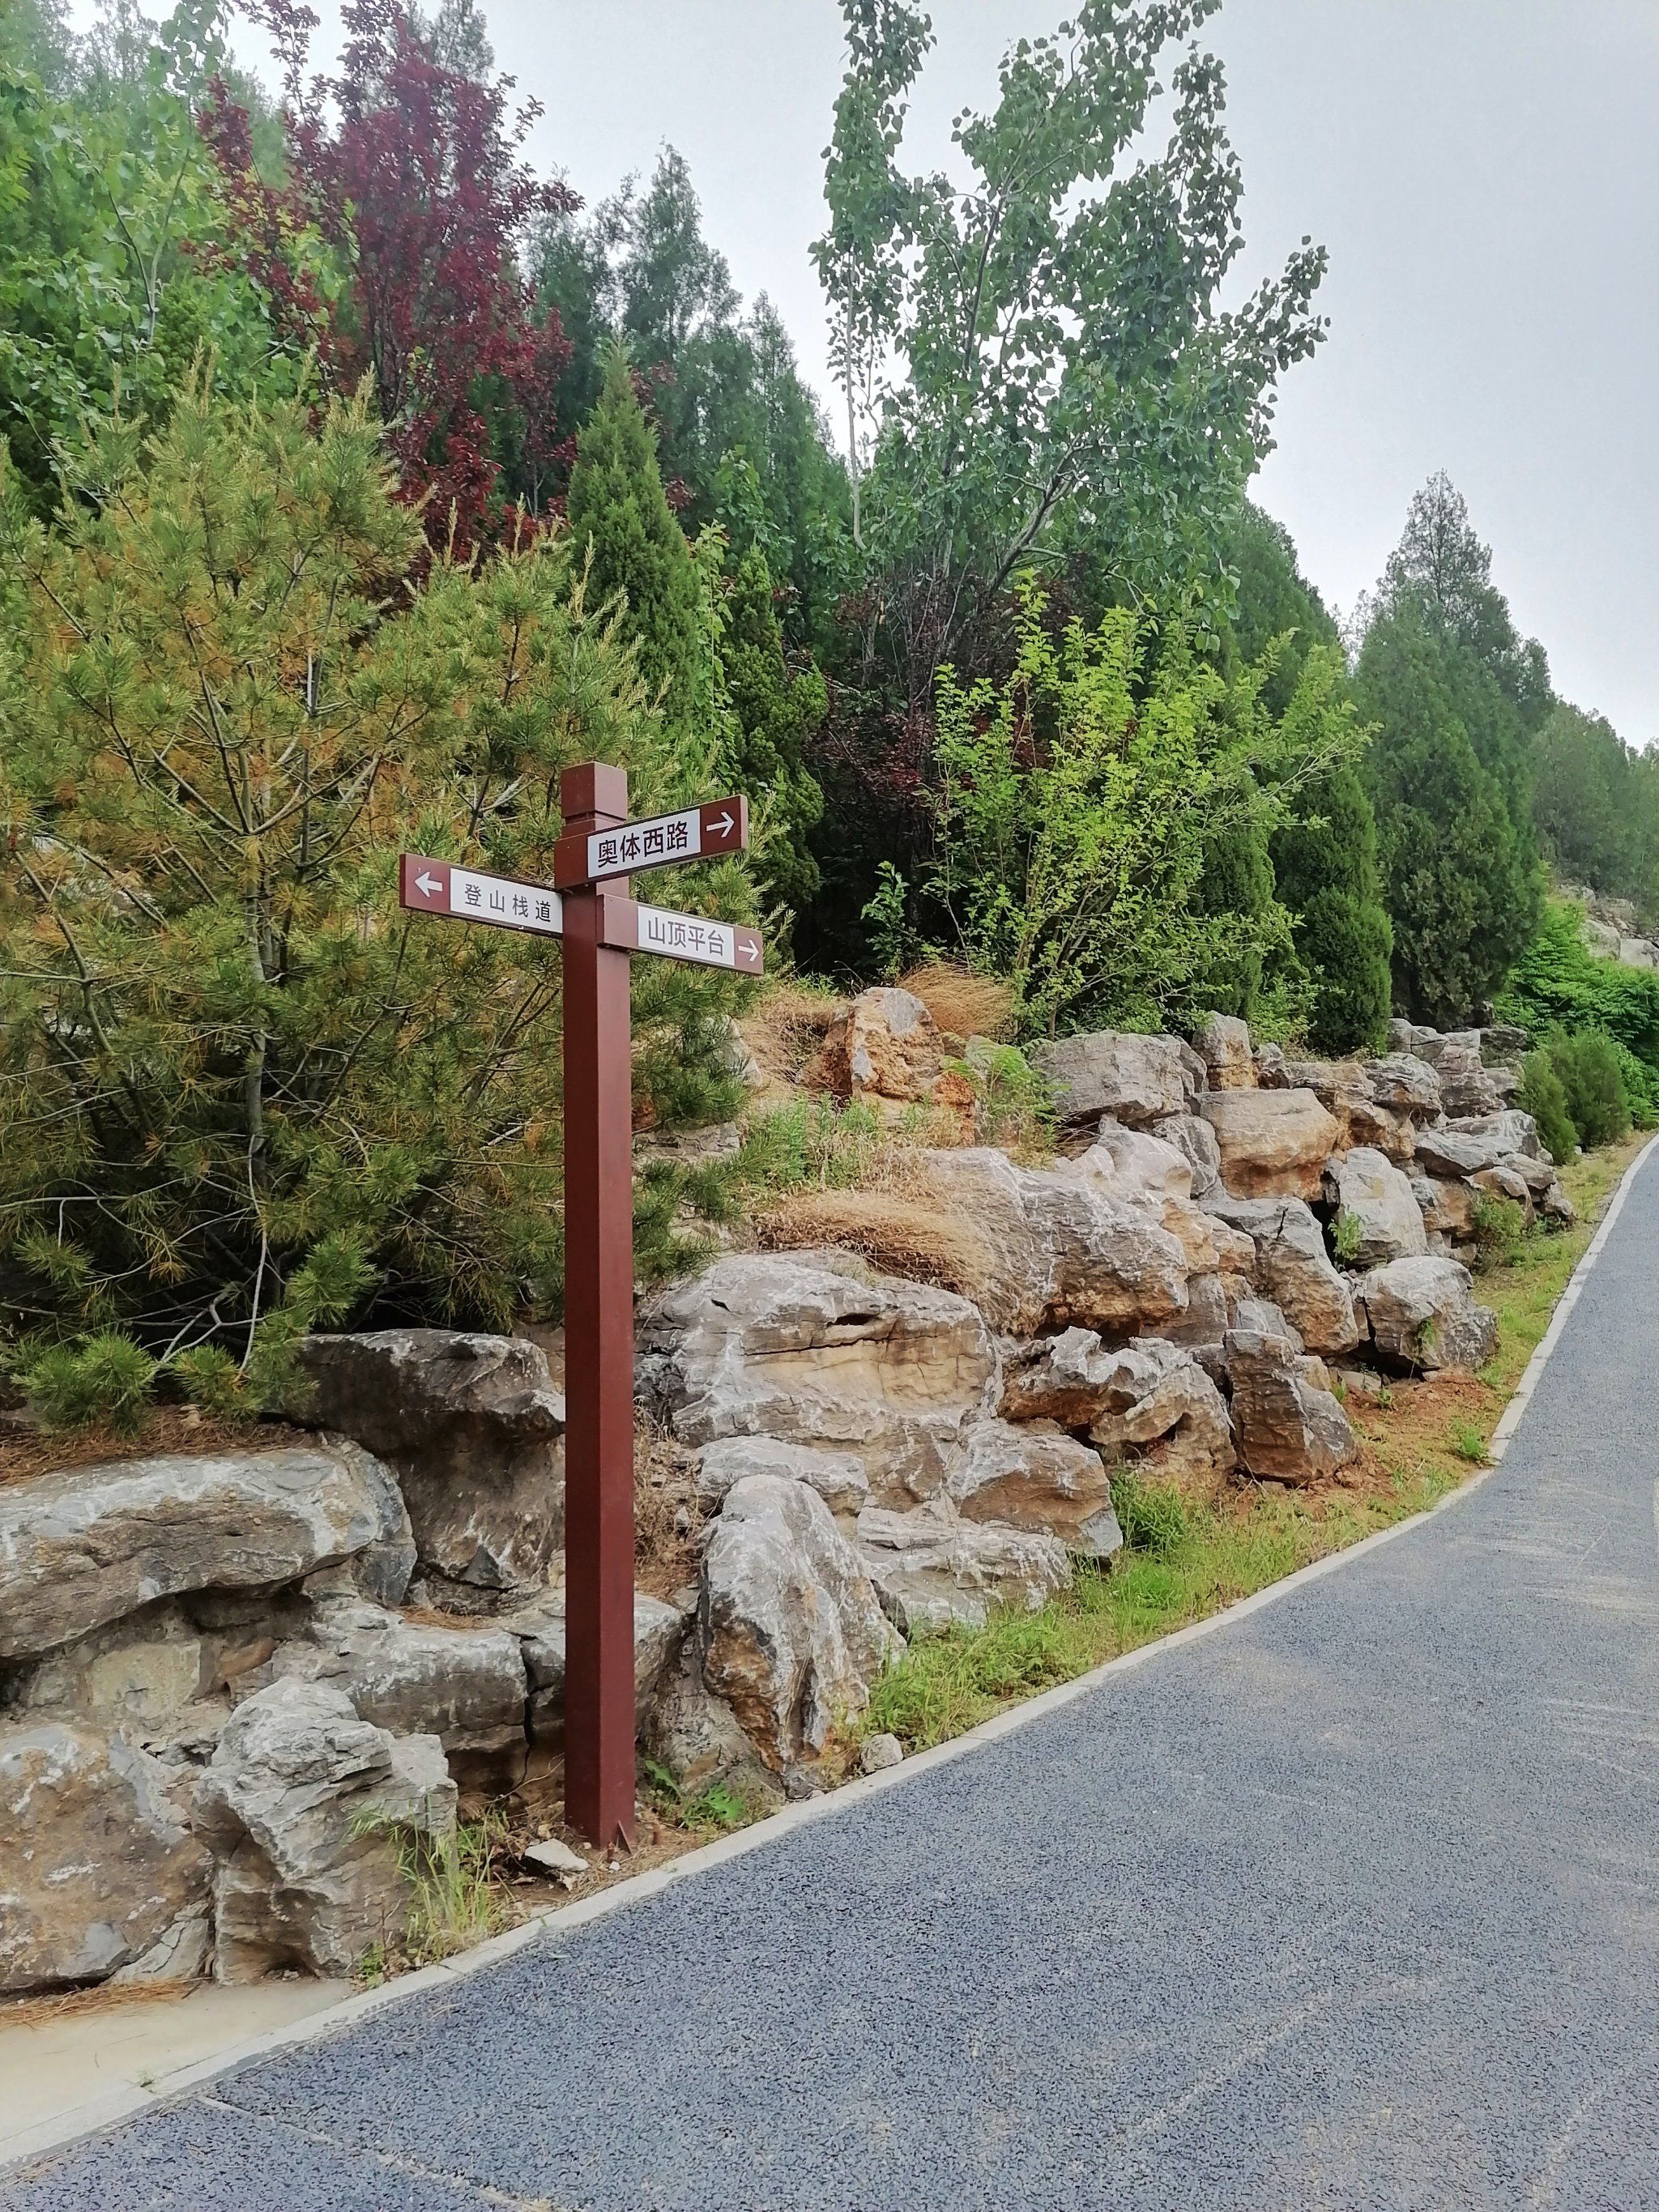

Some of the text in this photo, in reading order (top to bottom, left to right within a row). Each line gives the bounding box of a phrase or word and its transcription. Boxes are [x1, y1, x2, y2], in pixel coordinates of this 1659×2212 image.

[597, 820, 689, 868] 奥体西路
[464, 883, 552, 923] 登山栈道
[647, 917, 725, 957] 山顶平台
